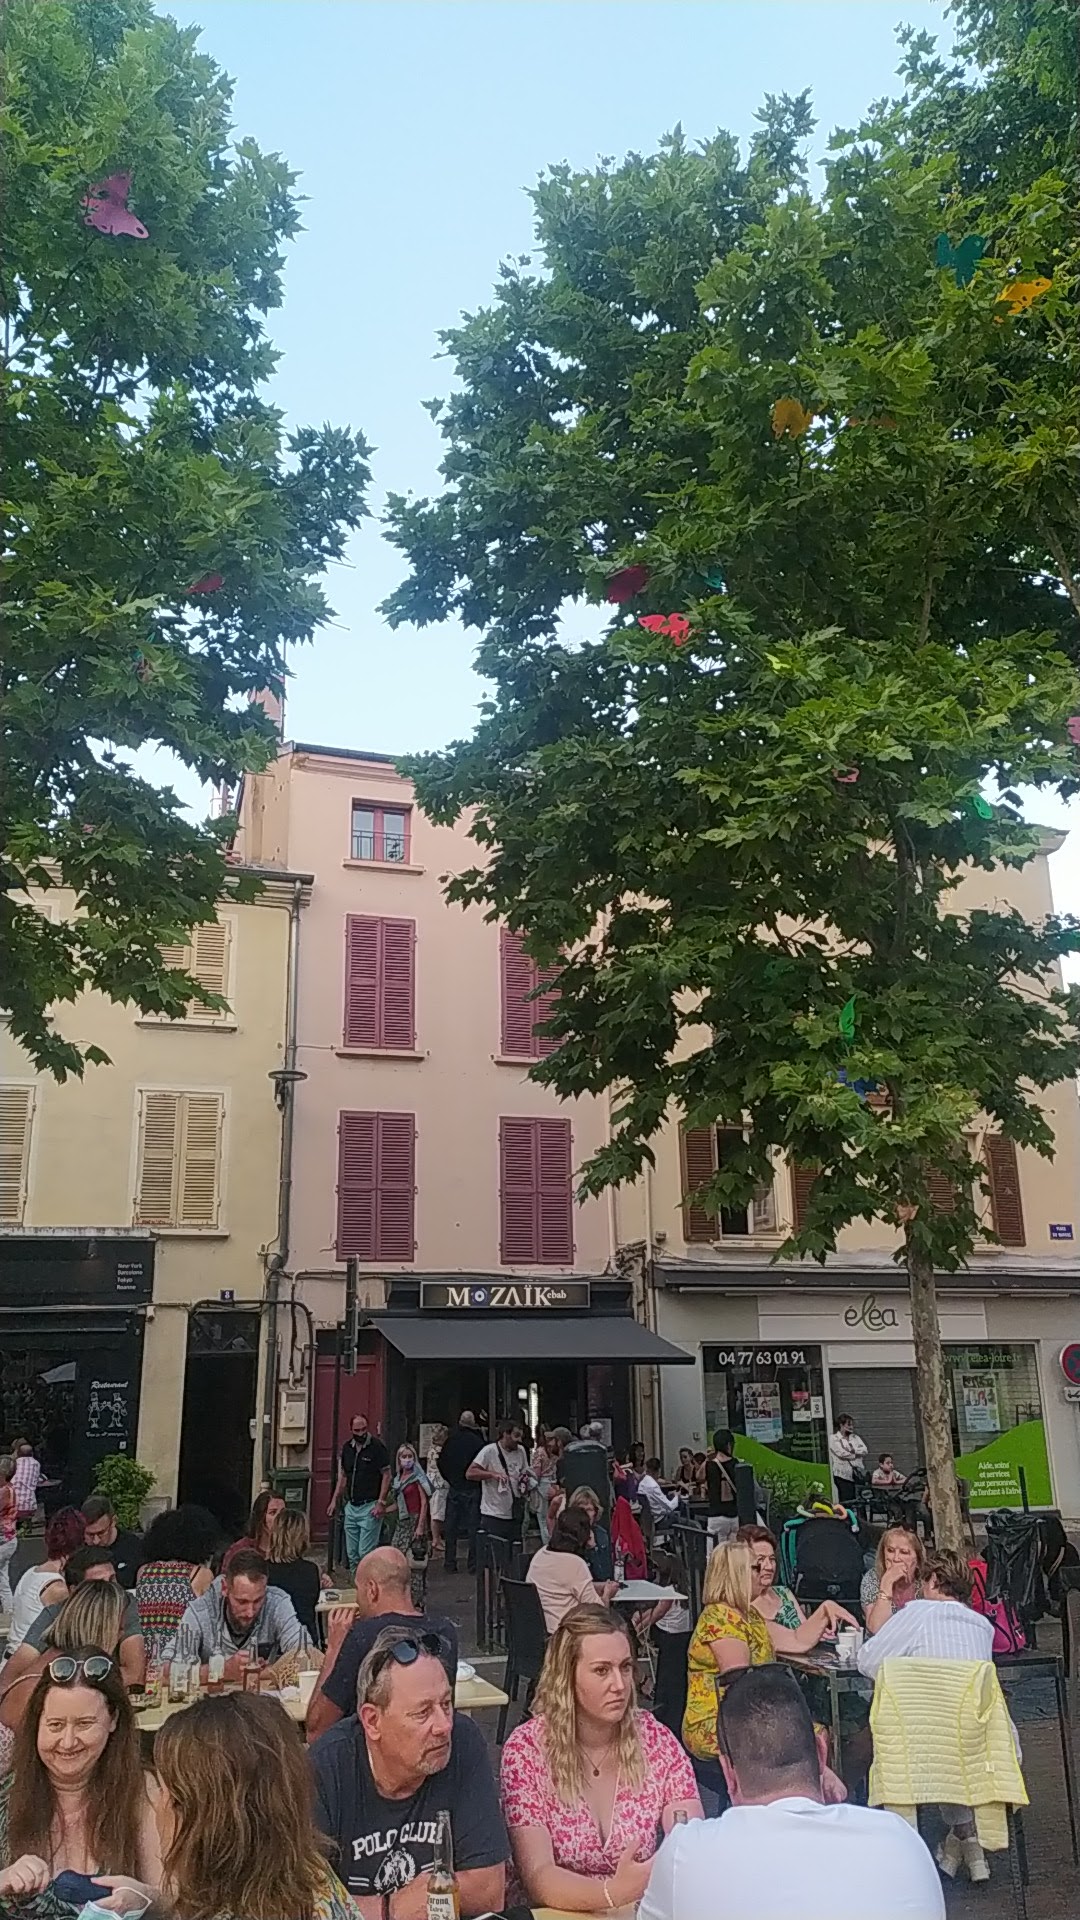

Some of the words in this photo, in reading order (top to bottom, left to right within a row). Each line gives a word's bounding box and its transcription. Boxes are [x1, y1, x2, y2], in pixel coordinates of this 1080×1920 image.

[844, 1294, 899, 1331] éléa
[718, 1351, 736, 1365] 04
[737, 1351, 754, 1365] 77
[756, 1351, 772, 1365] 63
[773, 1351, 789, 1365] 01
[790, 1350, 806, 1365] 91
[91, 1380, 129, 1389] Restaurant
[352, 1829, 398, 1861] POLO
